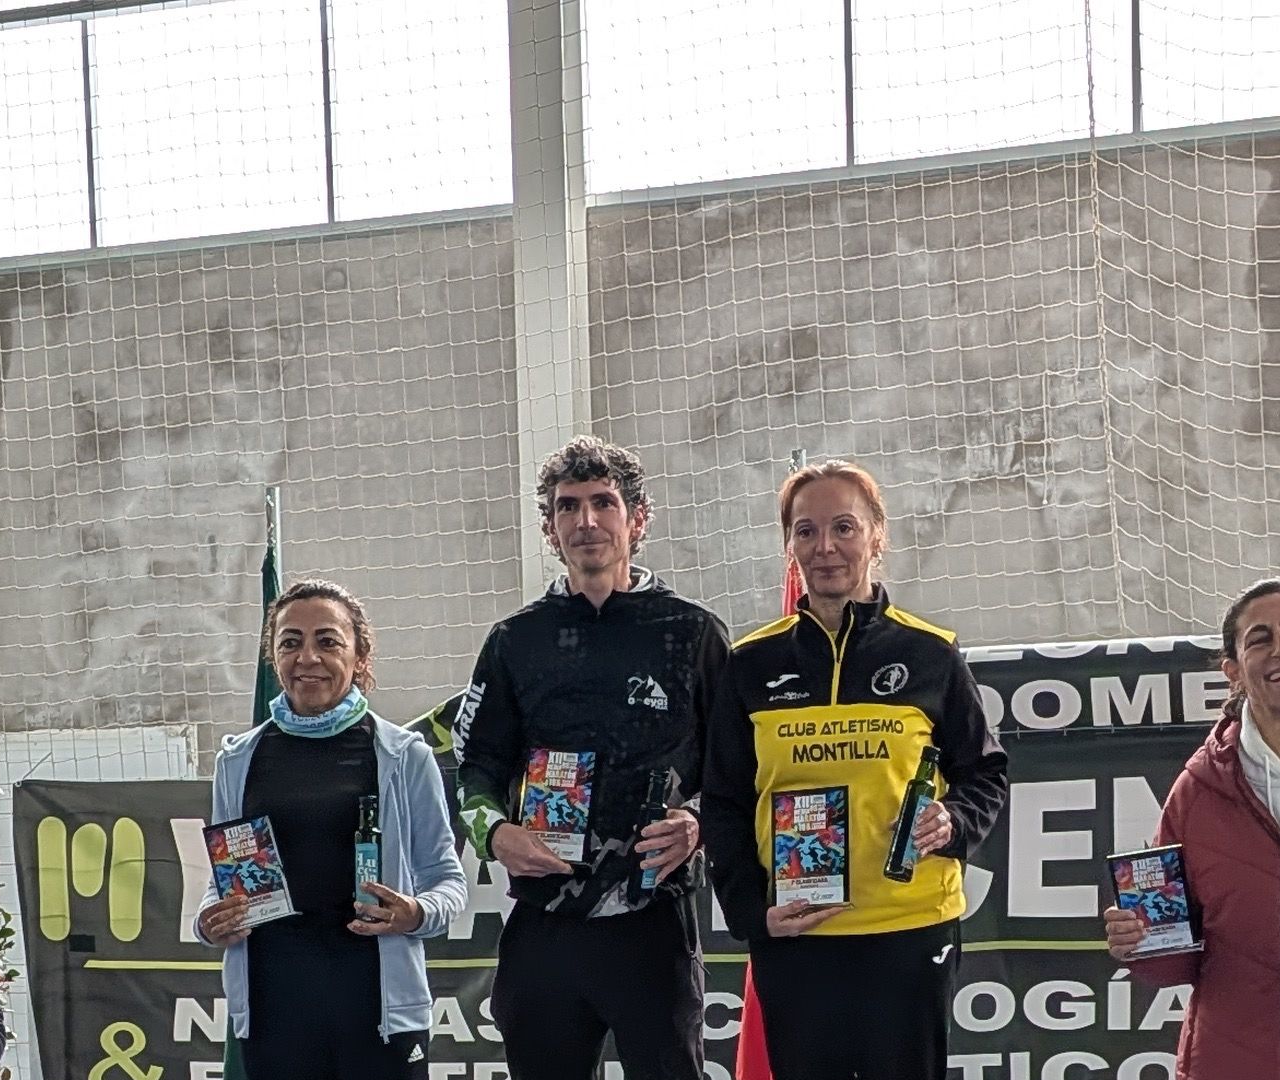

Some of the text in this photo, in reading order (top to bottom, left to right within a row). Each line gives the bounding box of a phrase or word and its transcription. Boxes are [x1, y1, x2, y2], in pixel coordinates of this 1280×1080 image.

[777, 718, 905, 738] CLUB ATLETISMO
[792, 739, 890, 764] MONTILLA
